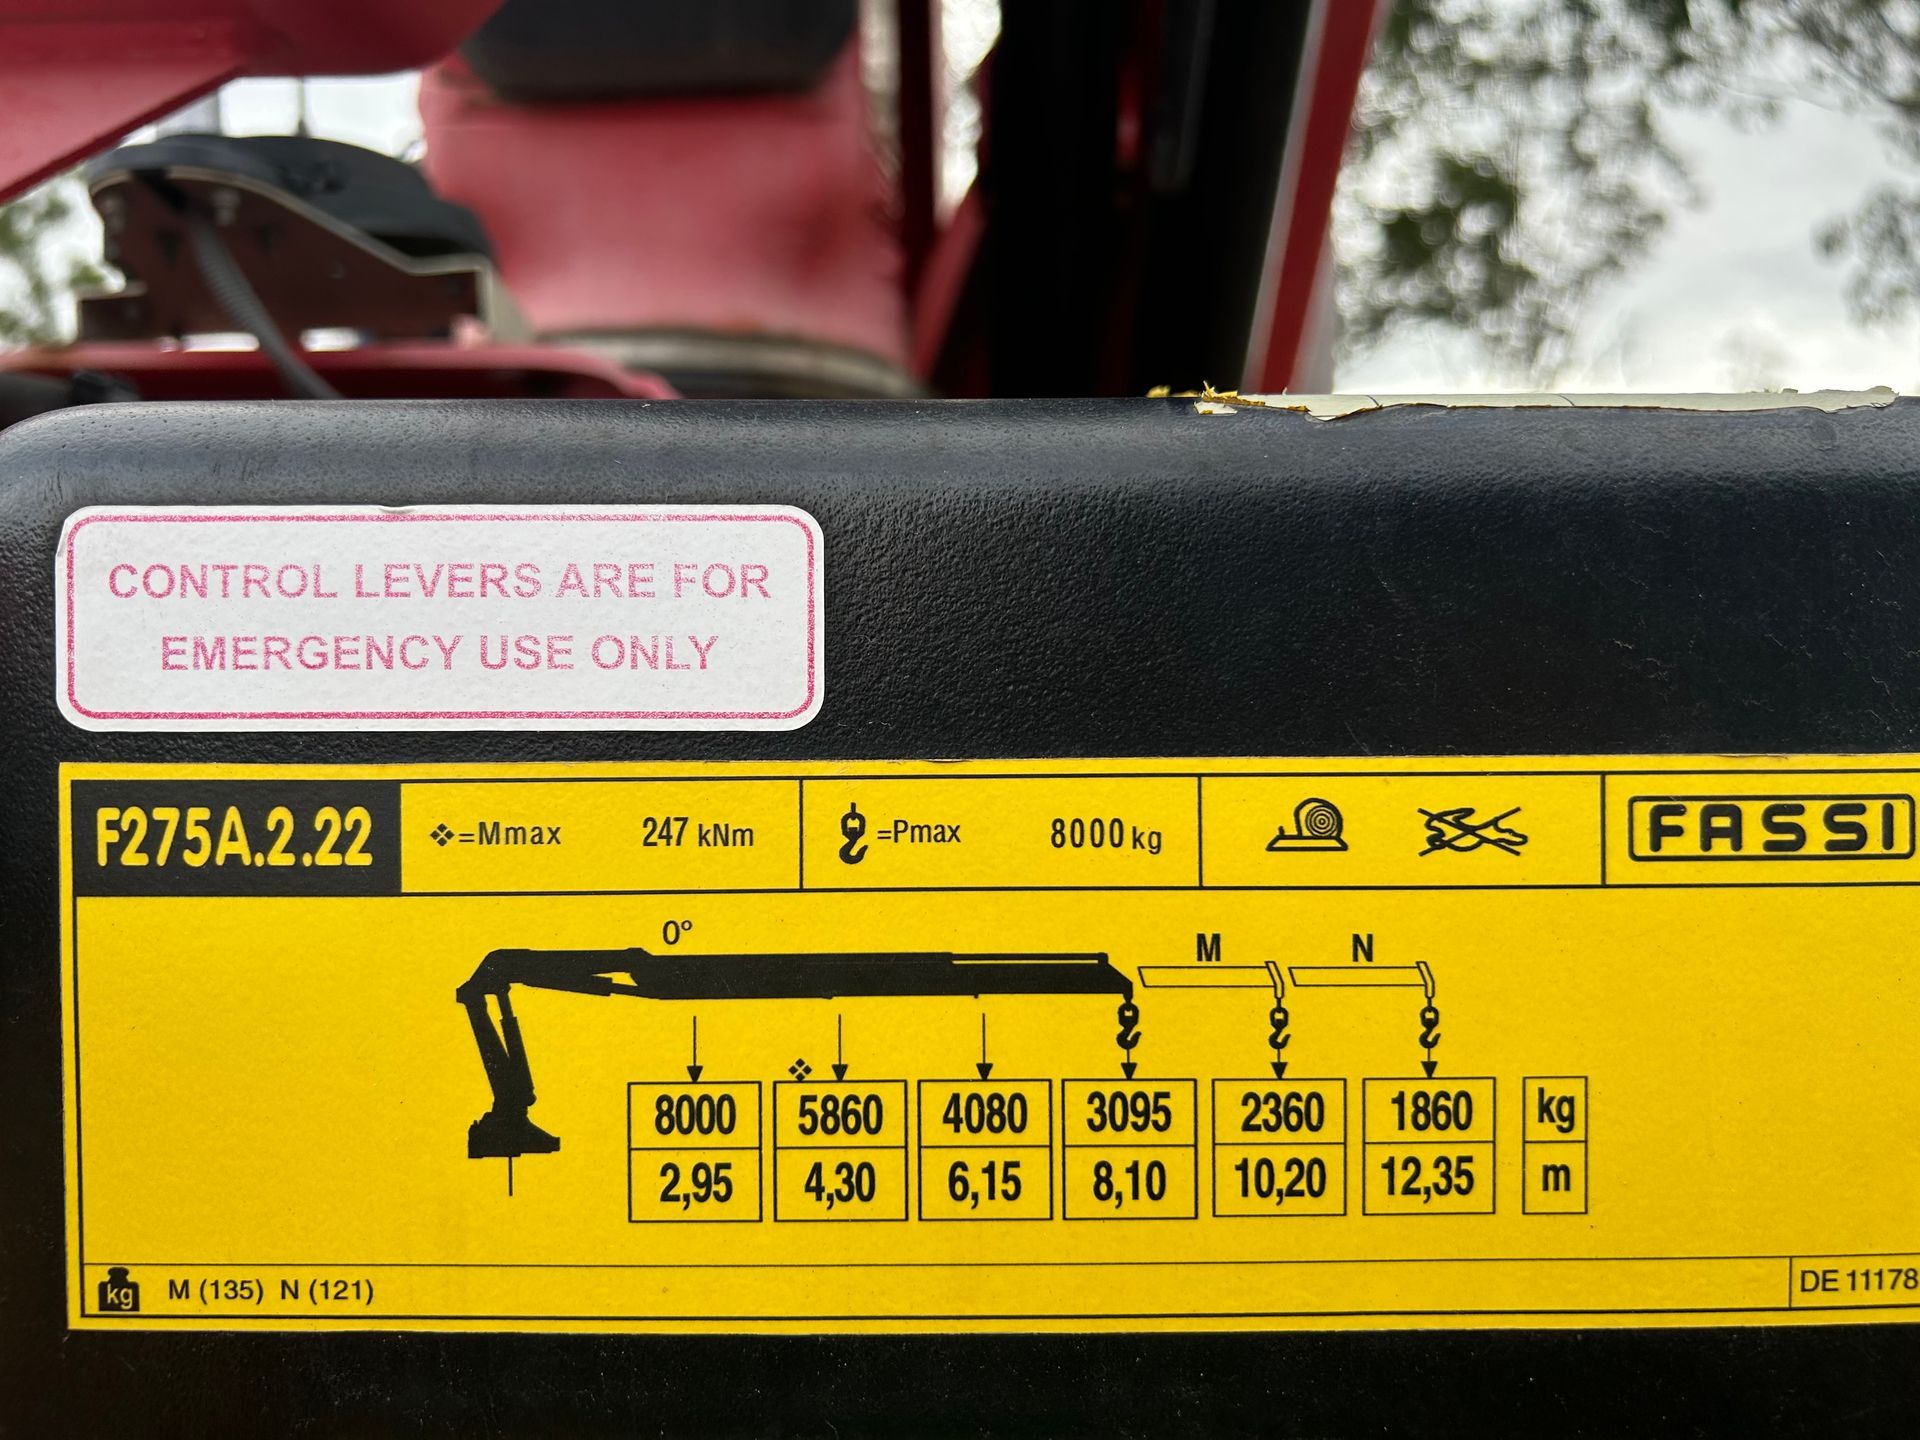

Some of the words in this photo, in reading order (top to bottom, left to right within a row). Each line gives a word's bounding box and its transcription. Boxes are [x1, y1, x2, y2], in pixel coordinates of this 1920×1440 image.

[108, 564, 336, 598] CONTROL
[356, 563, 540, 597] LEVERS
[557, 563, 653, 597] ARE
[674, 563, 771, 597] FOR
[162, 636, 458, 670] EMERGENCY
[481, 637, 573, 669] USE
[591, 636, 718, 670] ONLY
[97, 806, 372, 867] F275A.2.22
[643, 817, 688, 846] 247
[699, 824, 753, 846] kNm
[1052, 818, 1123, 848] 8000
[1133, 827, 1161, 854] kg
[1649, 802, 1894, 852] FASSI
[1197, 934, 1220, 961] M
[1353, 934, 1373, 962] N
[655, 1094, 736, 1135] 8000
[799, 1094, 883, 1135] 5860
[943, 1093, 1027, 1134] 4080
[1087, 1091, 1171, 1132] 3095
[1242, 1092, 1324, 1132] 2360
[1392, 1091, 1472, 1131] 1860
[1538, 1088, 1574, 1133] kg
[660, 1162, 732, 1210] 2,95
[805, 1162, 875, 1210] 4,30
[949, 1161, 1021, 1209] 6,15
[1094, 1160, 1166, 1208] 8,10
[1235, 1158, 1326, 1205] 10,20
[1382, 1156, 1474, 1203] 12,35
[1543, 1164, 1570, 1191] m
[106, 1283, 133, 1310] kg
[169, 1280, 189, 1299] M
[200, 1279, 263, 1304] (135)
[282, 1280, 298, 1299] N
[310, 1280, 373, 1305] (121)
[1801, 1270, 1838, 1292] DE
[1847, 1268, 1918, 1290] 11178
